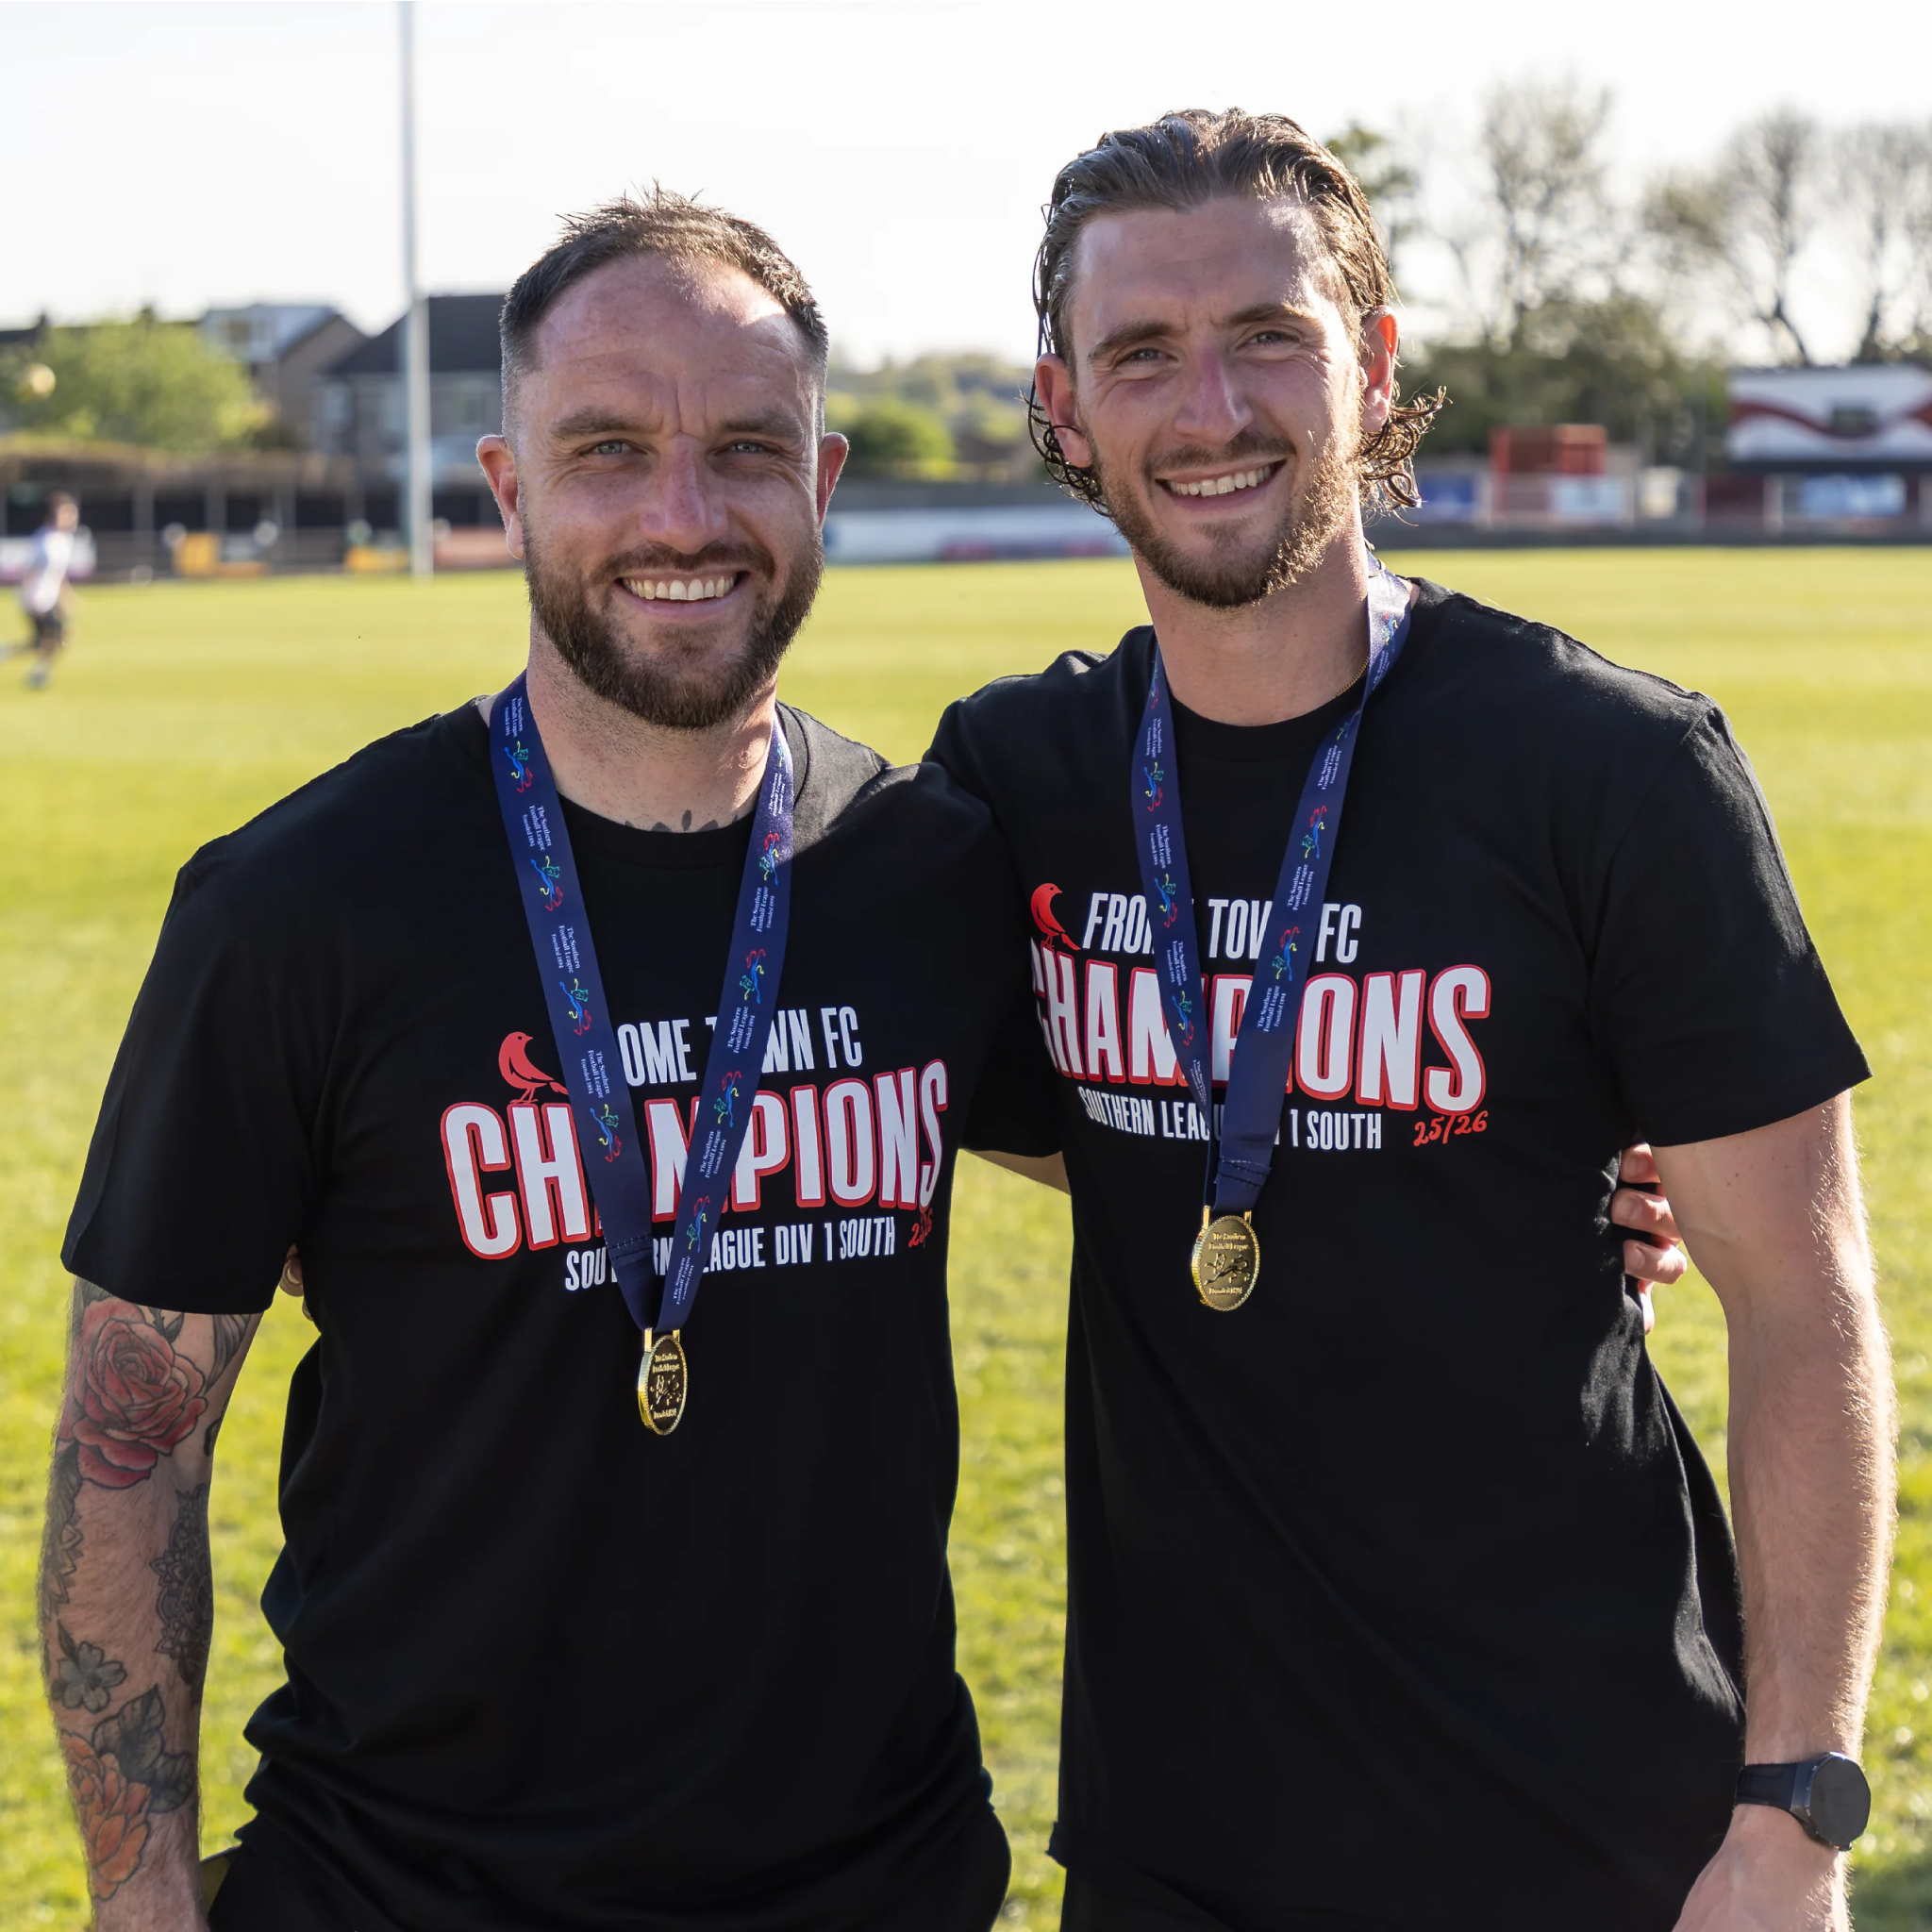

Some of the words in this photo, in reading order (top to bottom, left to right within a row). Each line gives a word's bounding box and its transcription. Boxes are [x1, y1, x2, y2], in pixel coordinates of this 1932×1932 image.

[757, 907, 765, 932] Football
[1292, 886, 1303, 910] Football
[558, 925, 571, 950] Football
[565, 951, 574, 973] League
[570, 940, 580, 968] Southern
[1315, 903, 1362, 963] FC
[730, 1007, 741, 1036] Southern
[1260, 988, 1273, 1015] Southern
[1263, 1007, 1274, 1032] Football
[1269, 985, 1280, 1007] League
[617, 1019, 698, 1087] OME
[820, 1006, 863, 1069] FC
[733, 1027, 743, 1054] Football
[739, 1006, 748, 1027] League
[588, 1049, 599, 1075] Football
[594, 1075, 604, 1099] League
[599, 1064, 609, 1094] Southern
[1078, 1086, 1157, 1137] SOUTHERN
[1306, 1110, 1383, 1151] SOUTH
[1414, 1111, 1489, 1148] 25/26
[441, 1059, 947, 1260] CHMPIONS
[705, 1152, 715, 1178] Football
[702, 1228, 766, 1274] AGUE
[775, 1223, 813, 1266] DIV
[824, 1222, 834, 1262] 1
[840, 1216, 895, 1260] SOUTH
